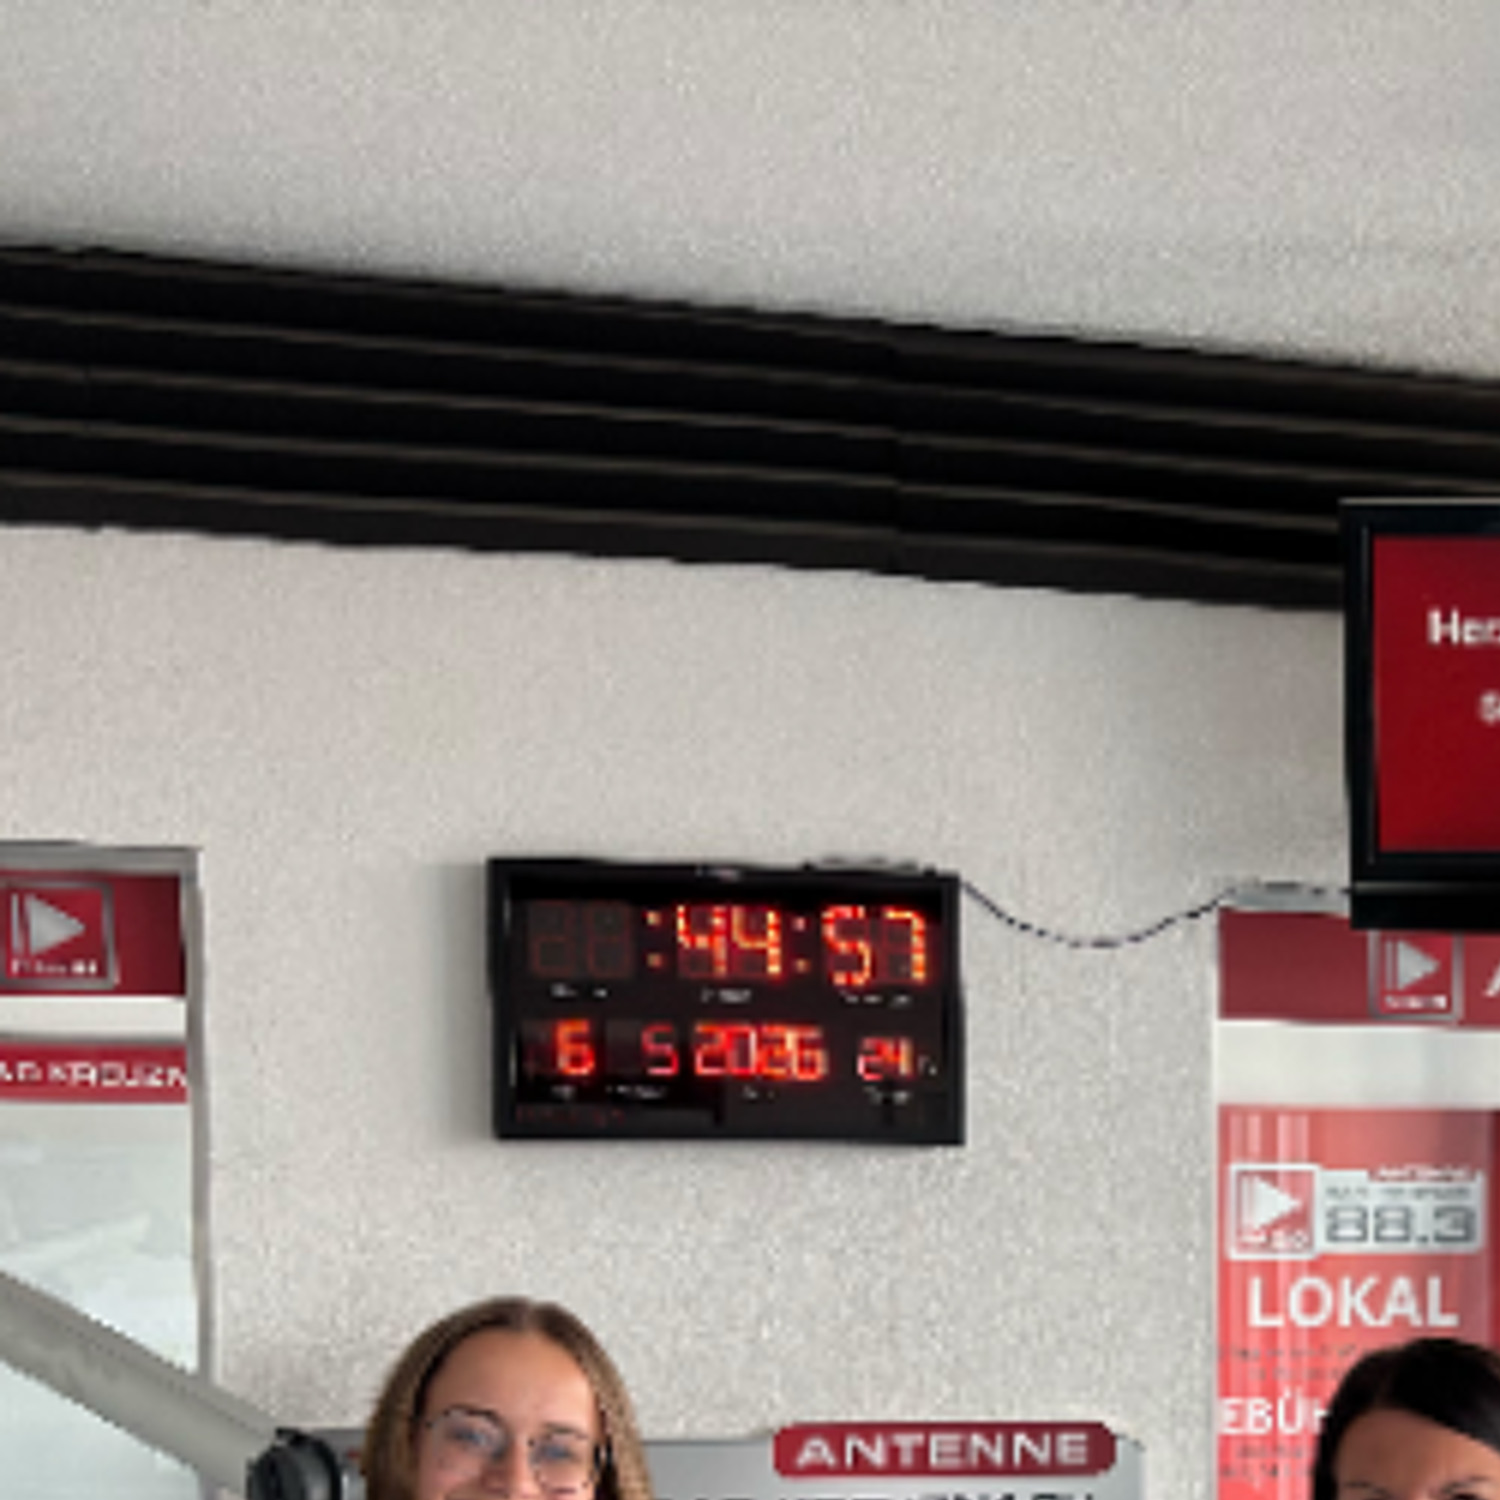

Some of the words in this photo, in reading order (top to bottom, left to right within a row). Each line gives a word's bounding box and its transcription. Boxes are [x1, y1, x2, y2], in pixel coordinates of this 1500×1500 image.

[1325, 1205, 1478, 1244] 88.3
[1248, 1275, 1460, 1327] LOKAL
[796, 1432, 1091, 1469] ANTENNE
